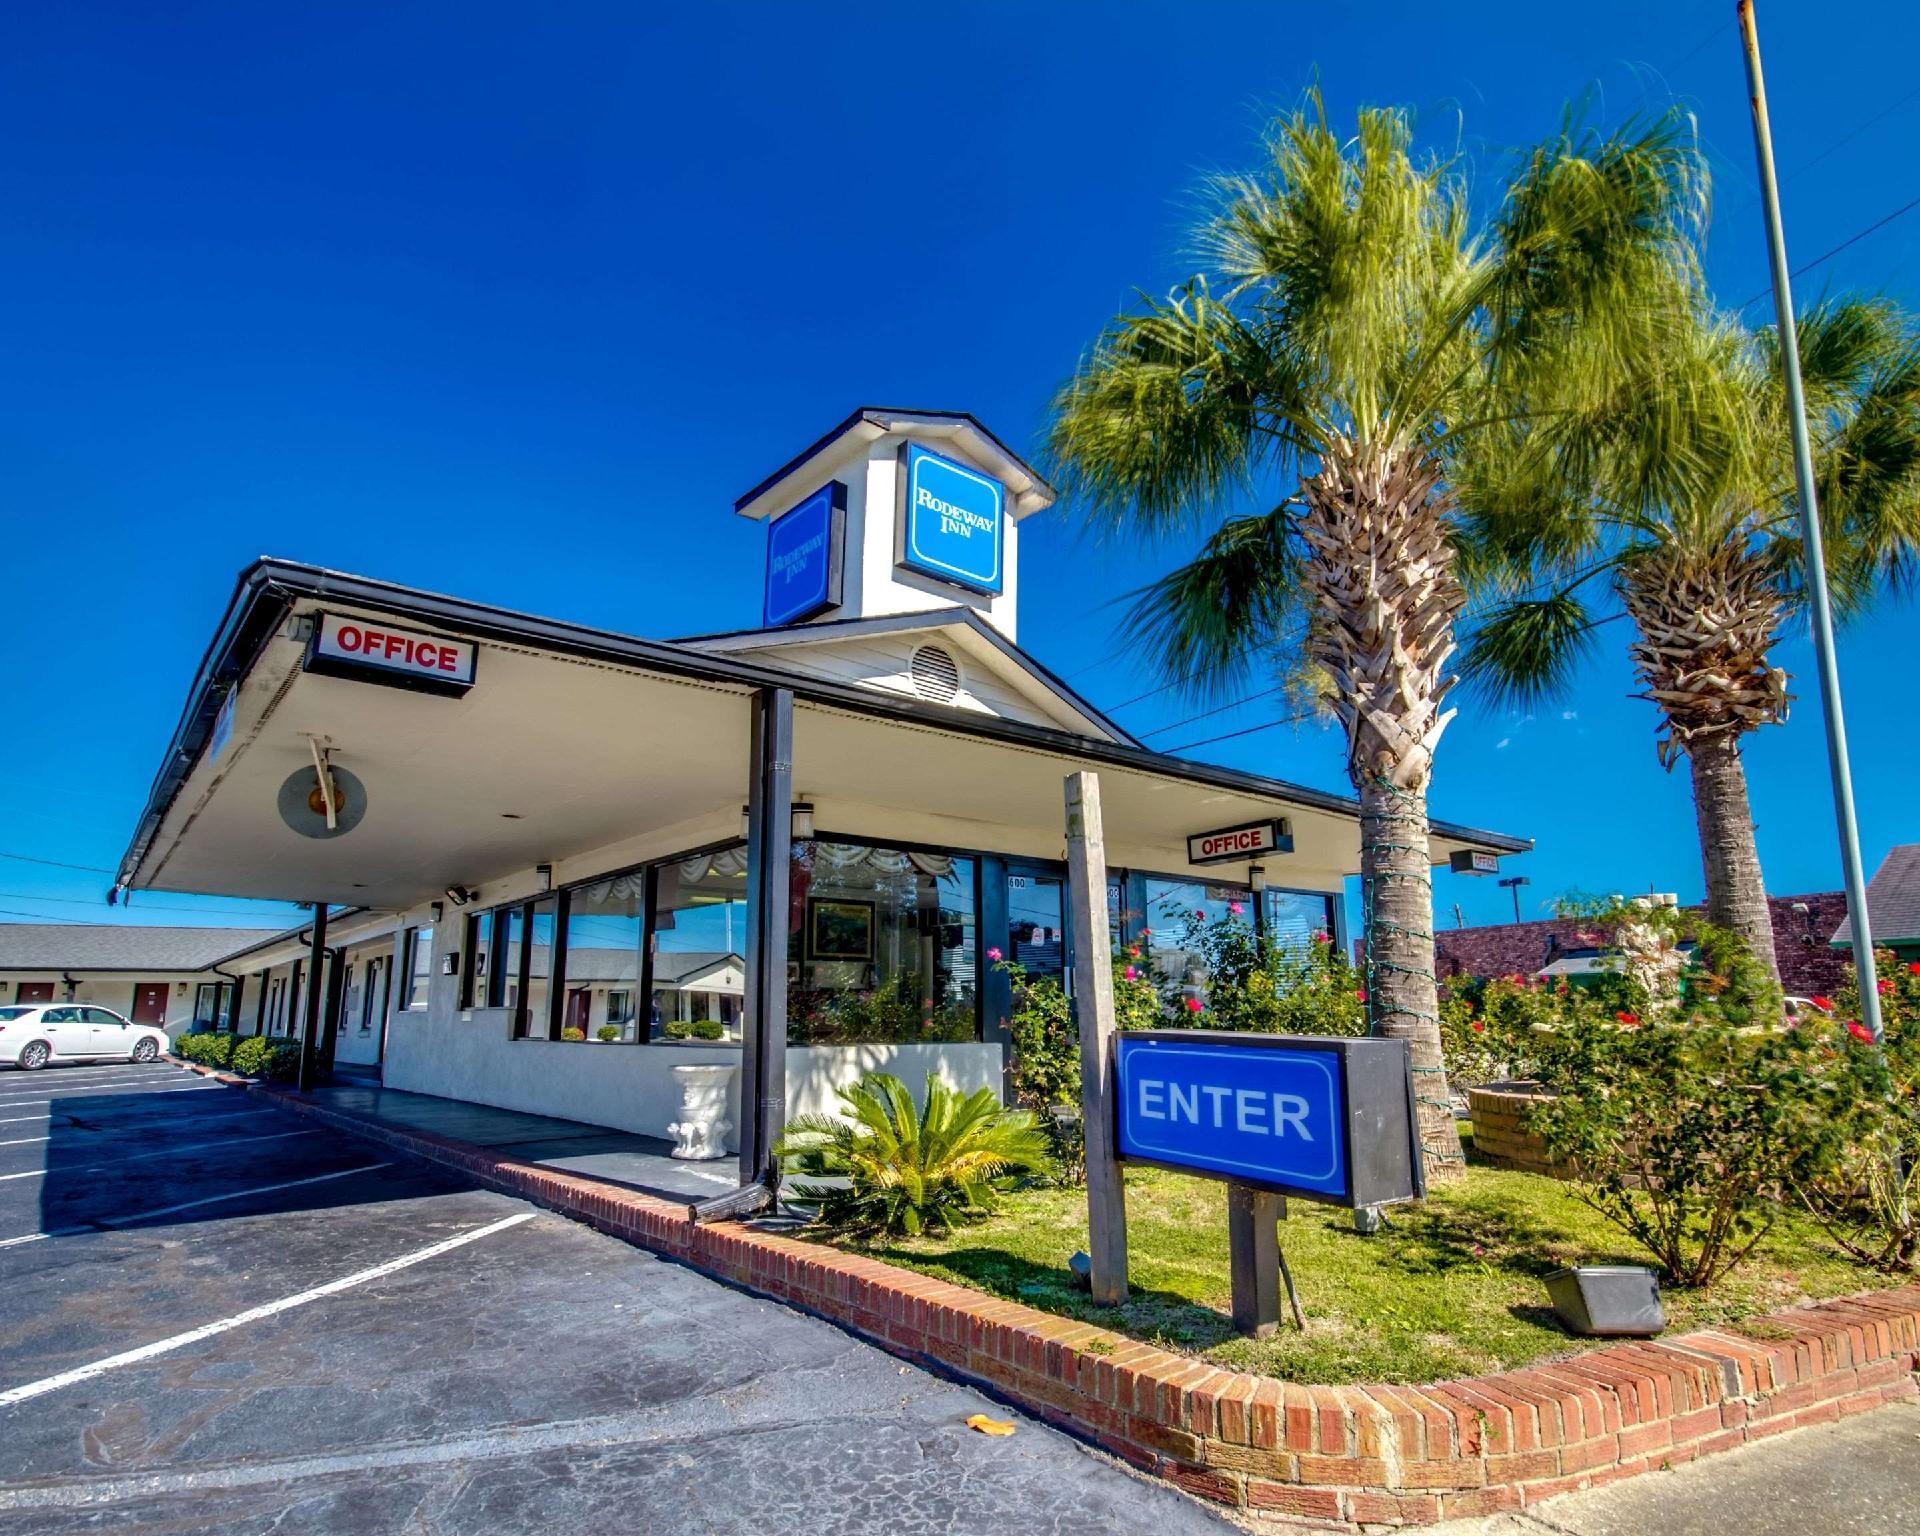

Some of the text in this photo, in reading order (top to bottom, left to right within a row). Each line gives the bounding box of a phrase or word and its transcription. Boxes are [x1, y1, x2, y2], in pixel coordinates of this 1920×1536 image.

[917, 487, 994, 533] RODEWAY
[940, 515, 971, 538] INN
[771, 532, 824, 576] RODEWAY
[784, 556, 807, 584] INN
[337, 626, 458, 672] OFFICE
[1202, 831, 1261, 855] OFFICE
[1009, 878, 1025, 888] 600
[1138, 1079, 1314, 1142] ENTER
